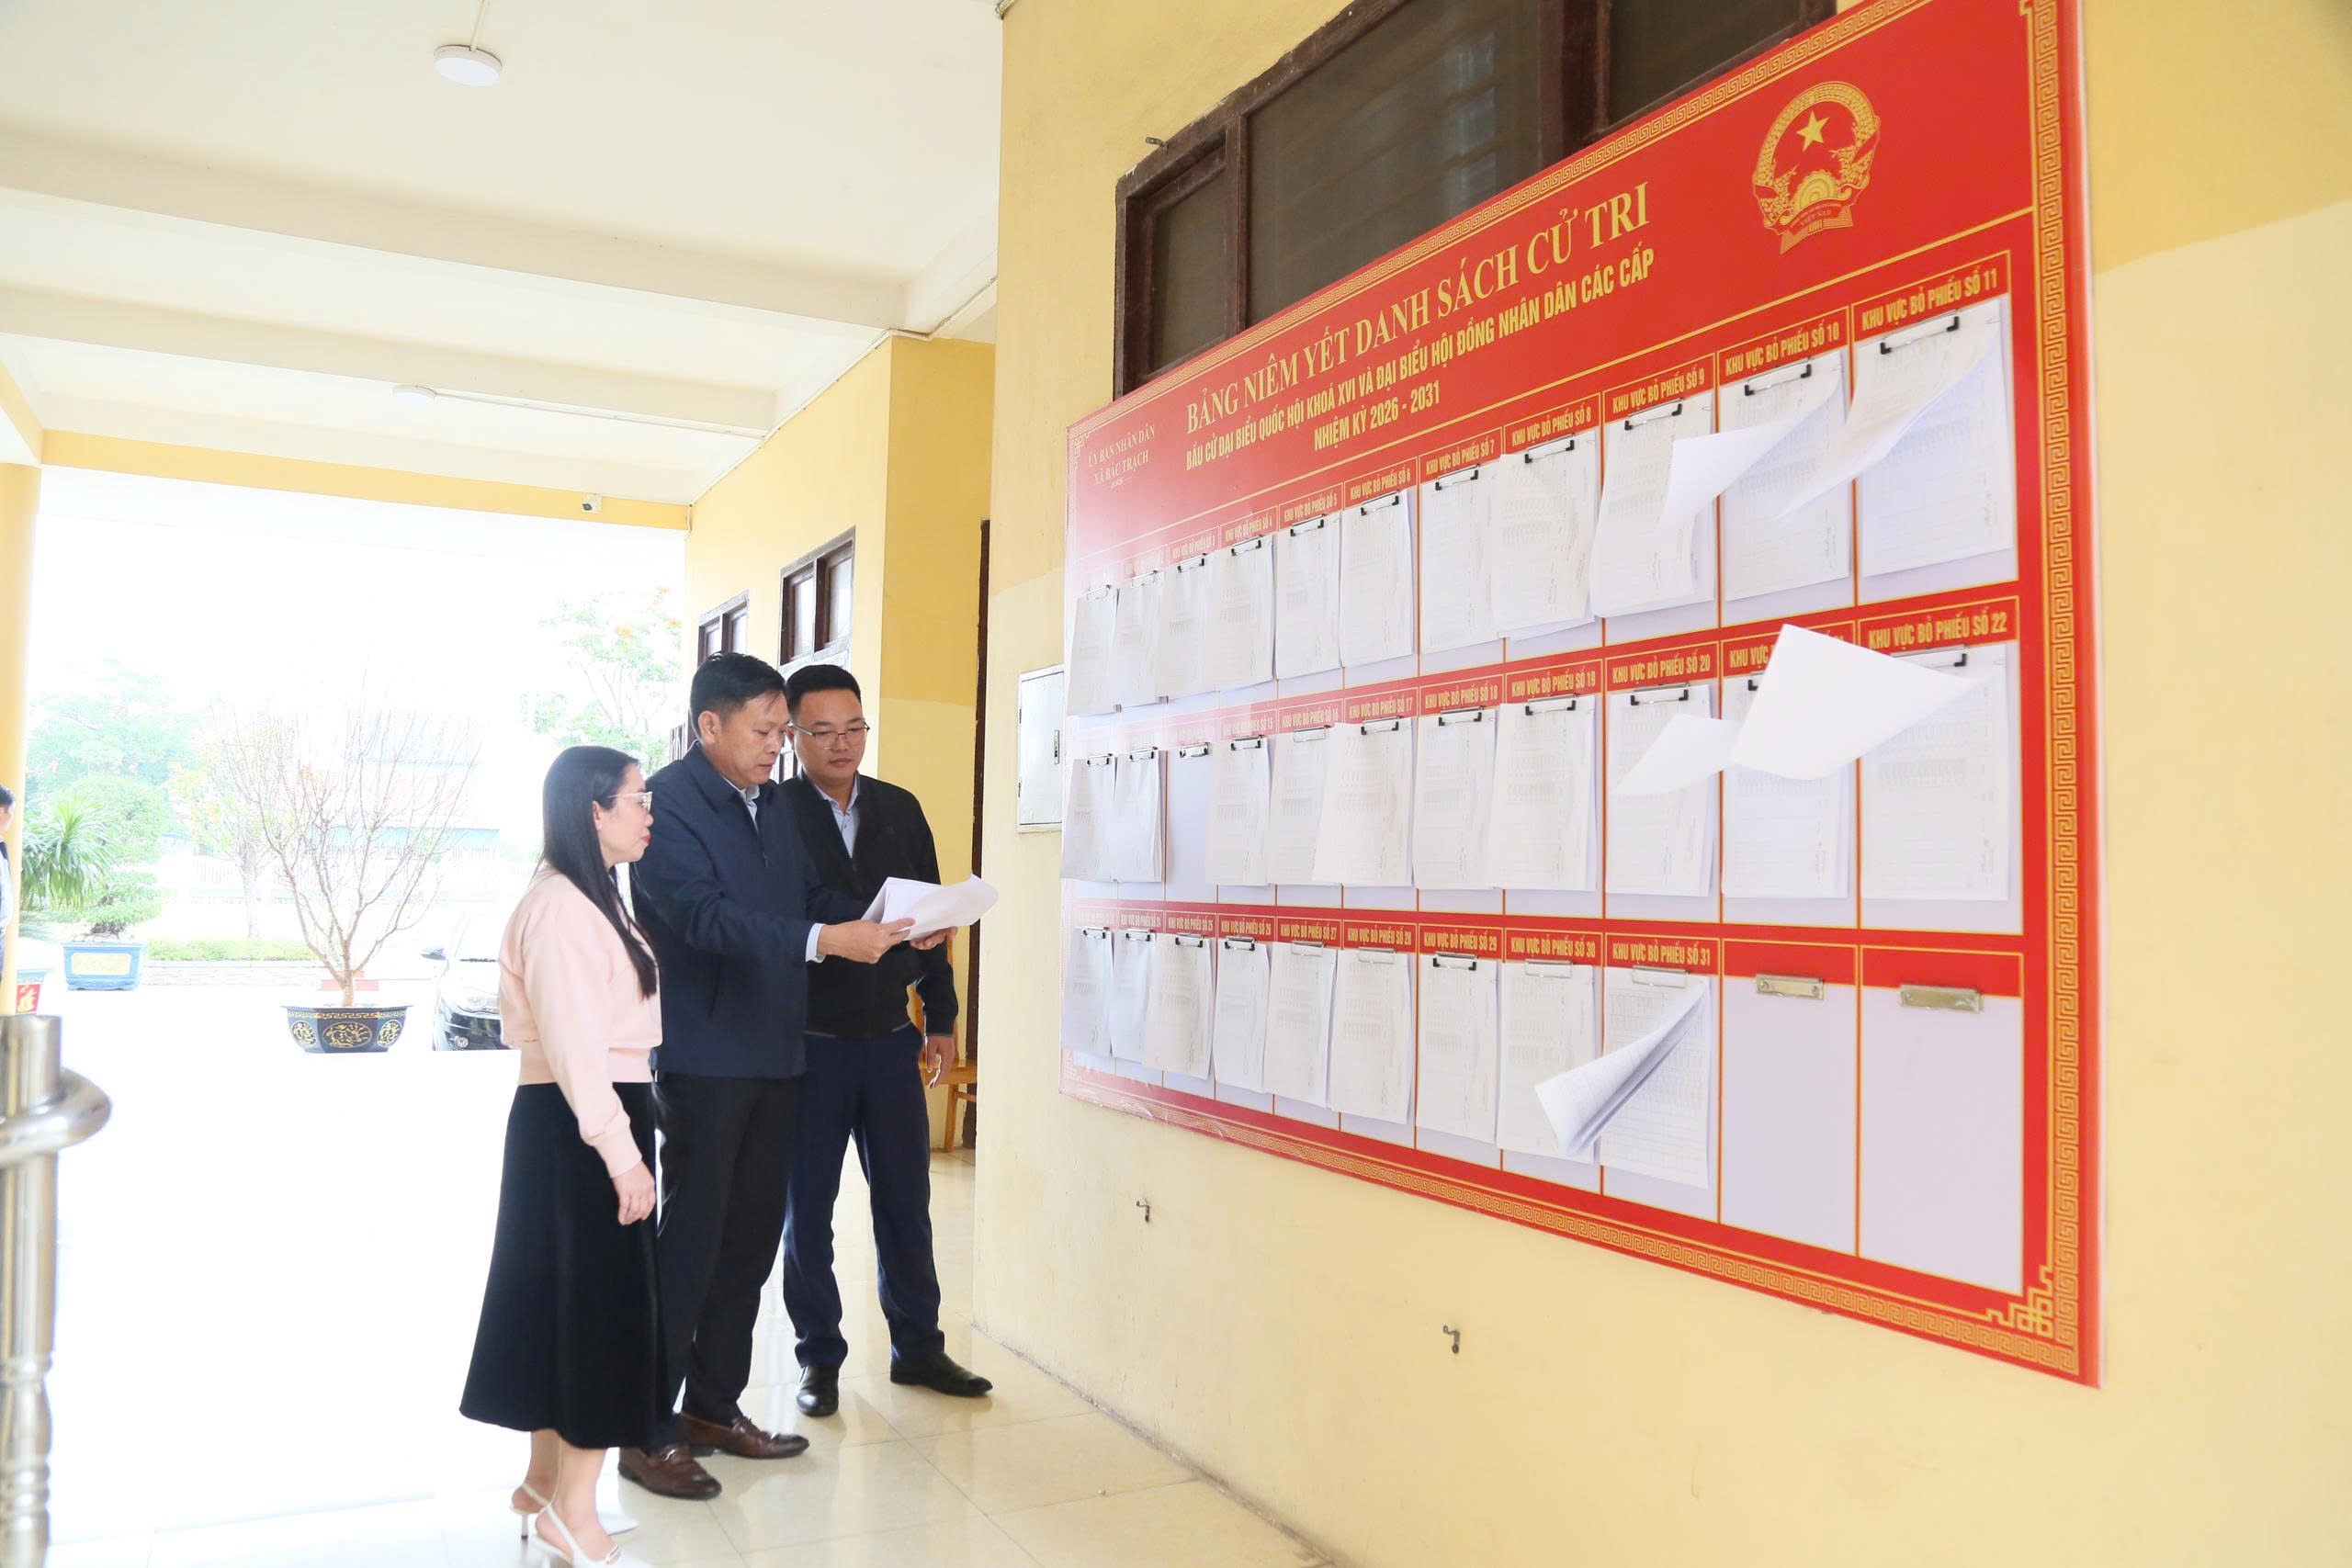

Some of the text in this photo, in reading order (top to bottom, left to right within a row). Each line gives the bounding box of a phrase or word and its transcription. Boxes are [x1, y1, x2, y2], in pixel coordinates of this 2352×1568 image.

[1186, 181, 1650, 434] BẢNG NIÊM YẾT DANH SÁCH CỬ TRI
[1861, 268, 1996, 330] KHU VỰC BỎ PHIẾU SỐ 11
[1218, 435, 1234, 458] ĐẠI
[1236, 415, 1256, 450] BIỂU
[1259, 403, 1284, 441] QUỐC
[1287, 398, 1305, 430] HỘI
[1338, 378, 1356, 407] XVI
[1359, 367, 1374, 397] VÀ
[1376, 360, 1396, 390] ĐẠI
[1399, 339, 1428, 380] BIỂU
[1431, 330, 1453, 368] HỘI
[1456, 317, 1495, 357] ĐỒNG
[1498, 297, 1540, 339] NHÂN
[1544, 280, 1577, 321] DÂN
[1581, 264, 1614, 304] CÁC
[1619, 241, 1655, 288] CẤP
[1726, 321, 1838, 375] KHU VỰC BỎ PHIẾU SỐ 10
[1612, 365, 1704, 413] KHU VỰC BỎ PHIẾU SỐ 9
[1314, 416, 1350, 452] NHIỆM
[1352, 404, 1367, 436] KỲ
[1370, 396, 1398, 429] 2026
[1410, 379, 1441, 414] 2031
[1512, 428, 1525, 446] KHU
[1527, 423, 1540, 442] VỰC
[1553, 410, 1572, 432] PHIẾU
[1575, 404, 1584, 425] SỐ
[1586, 407, 1590, 422] 8
[1490, 439, 1494, 453] 7
[1869, 627, 1889, 649] KHU
[1893, 623, 1914, 649] VỰC
[1917, 615, 1932, 642] BỎ
[1936, 612, 1968, 640] PHIẾU
[1973, 608, 1987, 636] SỐ
[1990, 613, 2007, 634] 22
[1612, 649, 1710, 683] KHU VỰC BỎ PHIẾU SỐ 20
[1730, 648, 1747, 668] KHU
[1750, 644, 1768, 668] VỰC
[1512, 680, 1525, 695] KHU
[1527, 677, 1540, 696] VỰC
[1553, 669, 1573, 691] PHIẾU
[1575, 667, 1585, 689] SỐ
[1586, 671, 1595, 687] 19
[1406, 698, 1412, 711] 17
[1424, 931, 1435, 946] KHU
[1510, 937, 1524, 953] KHU
[1526, 937, 1539, 956] VỰC
[1553, 934, 1573, 954] PHIẾU
[1575, 935, 1584, 955] SỐ
[1612, 939, 1710, 964] KHU VỰC BỎ PHIẾU SỐ 31
